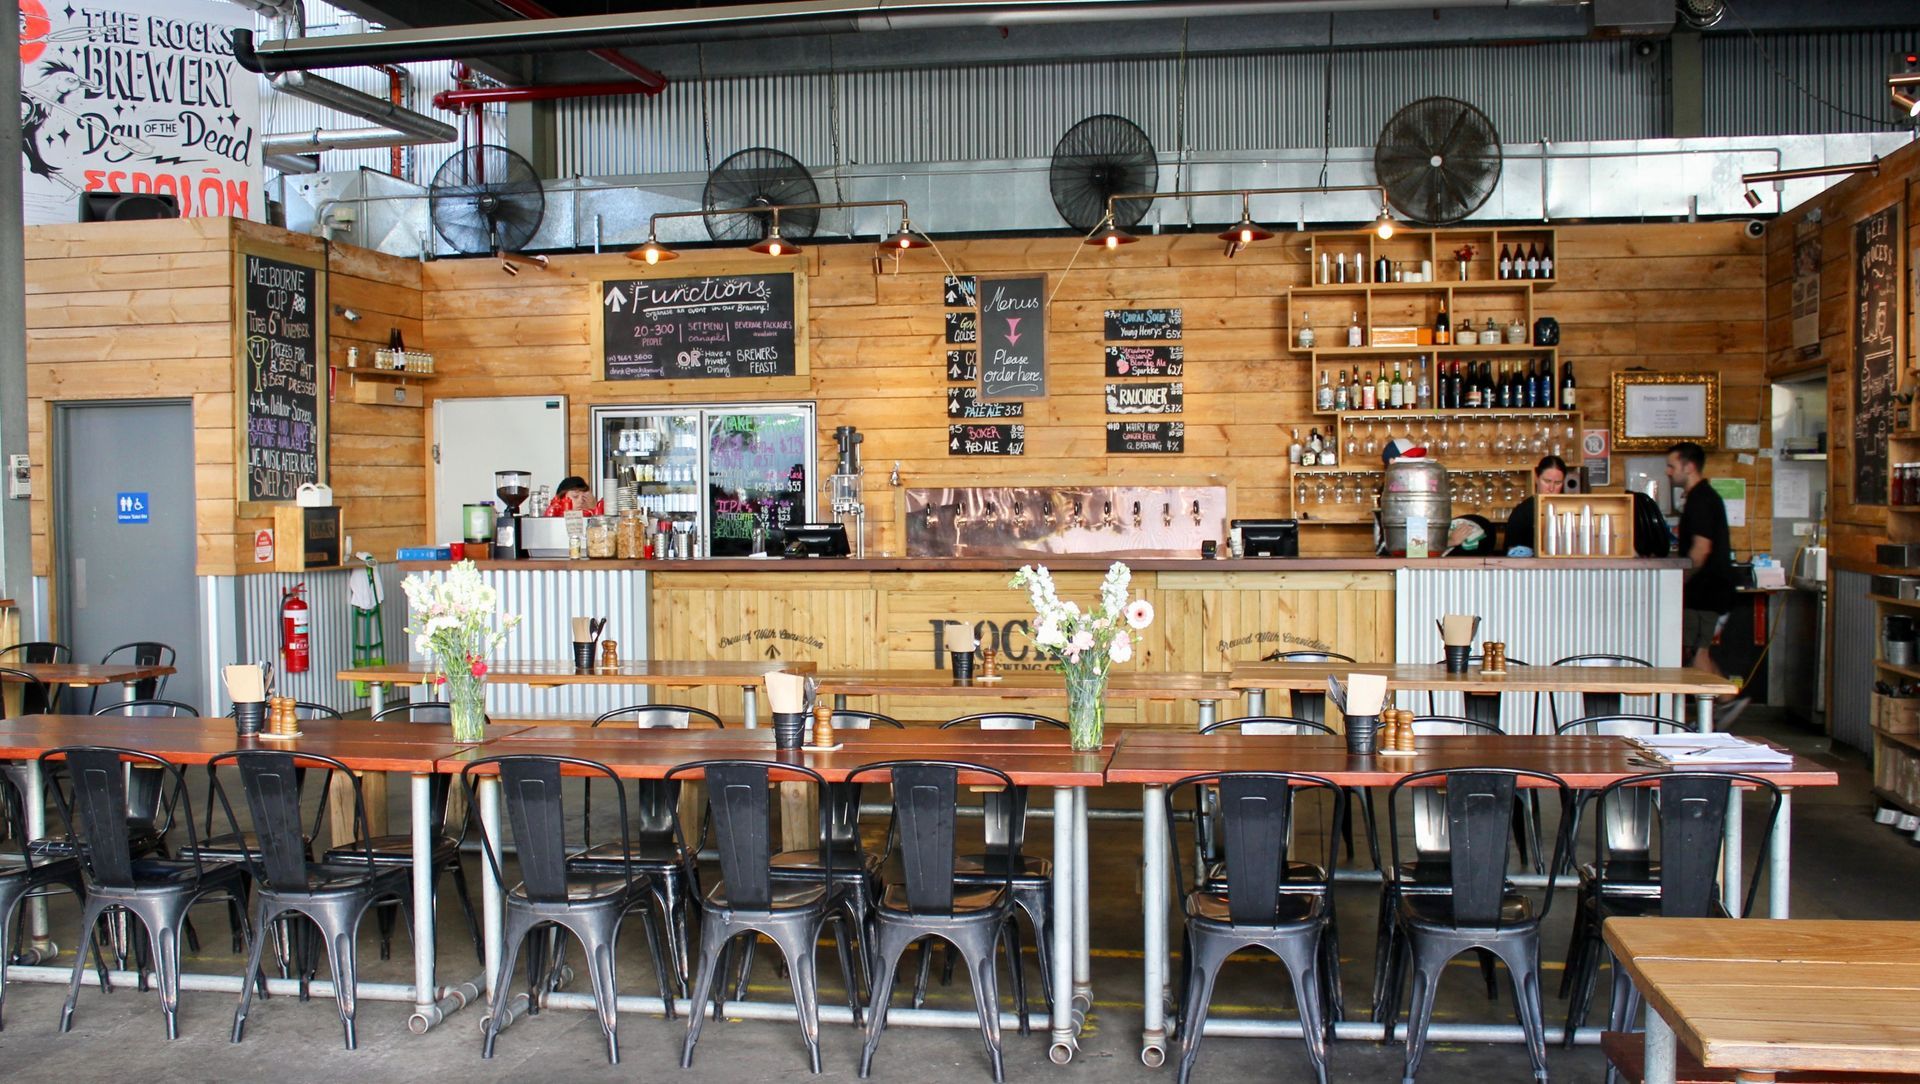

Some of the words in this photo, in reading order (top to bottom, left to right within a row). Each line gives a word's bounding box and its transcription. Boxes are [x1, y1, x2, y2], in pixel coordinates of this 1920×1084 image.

[81, 6, 140, 46] THE
[148, 15, 237, 58] ROCKS
[82, 45, 238, 108] BREWERY
[77, 112, 141, 163] Day
[144, 123, 157, 135] OF
[158, 122, 178, 134] THE
[180, 110, 253, 167] Dead
[249, 257, 305, 293] MELBOURNE
[266, 289, 288, 311] CUP
[632, 278, 766, 314] Functions
[983, 286, 1039, 312] Menus
[703, 322, 724, 331] MENU
[1120, 326, 1138, 339] Young
[1139, 324, 1162, 339] Henrys
[677, 350, 701, 368] OR
[737, 346, 778, 362] BREWERS
[993, 348, 1029, 366] Please
[707, 364, 731, 377] Dining
[750, 361, 778, 374] FEAST!
[983, 366, 1017, 383] order
[288, 377, 317, 397] DRESSED
[967, 426, 1001, 441] BOXER
[983, 440, 1000, 453] ALE
